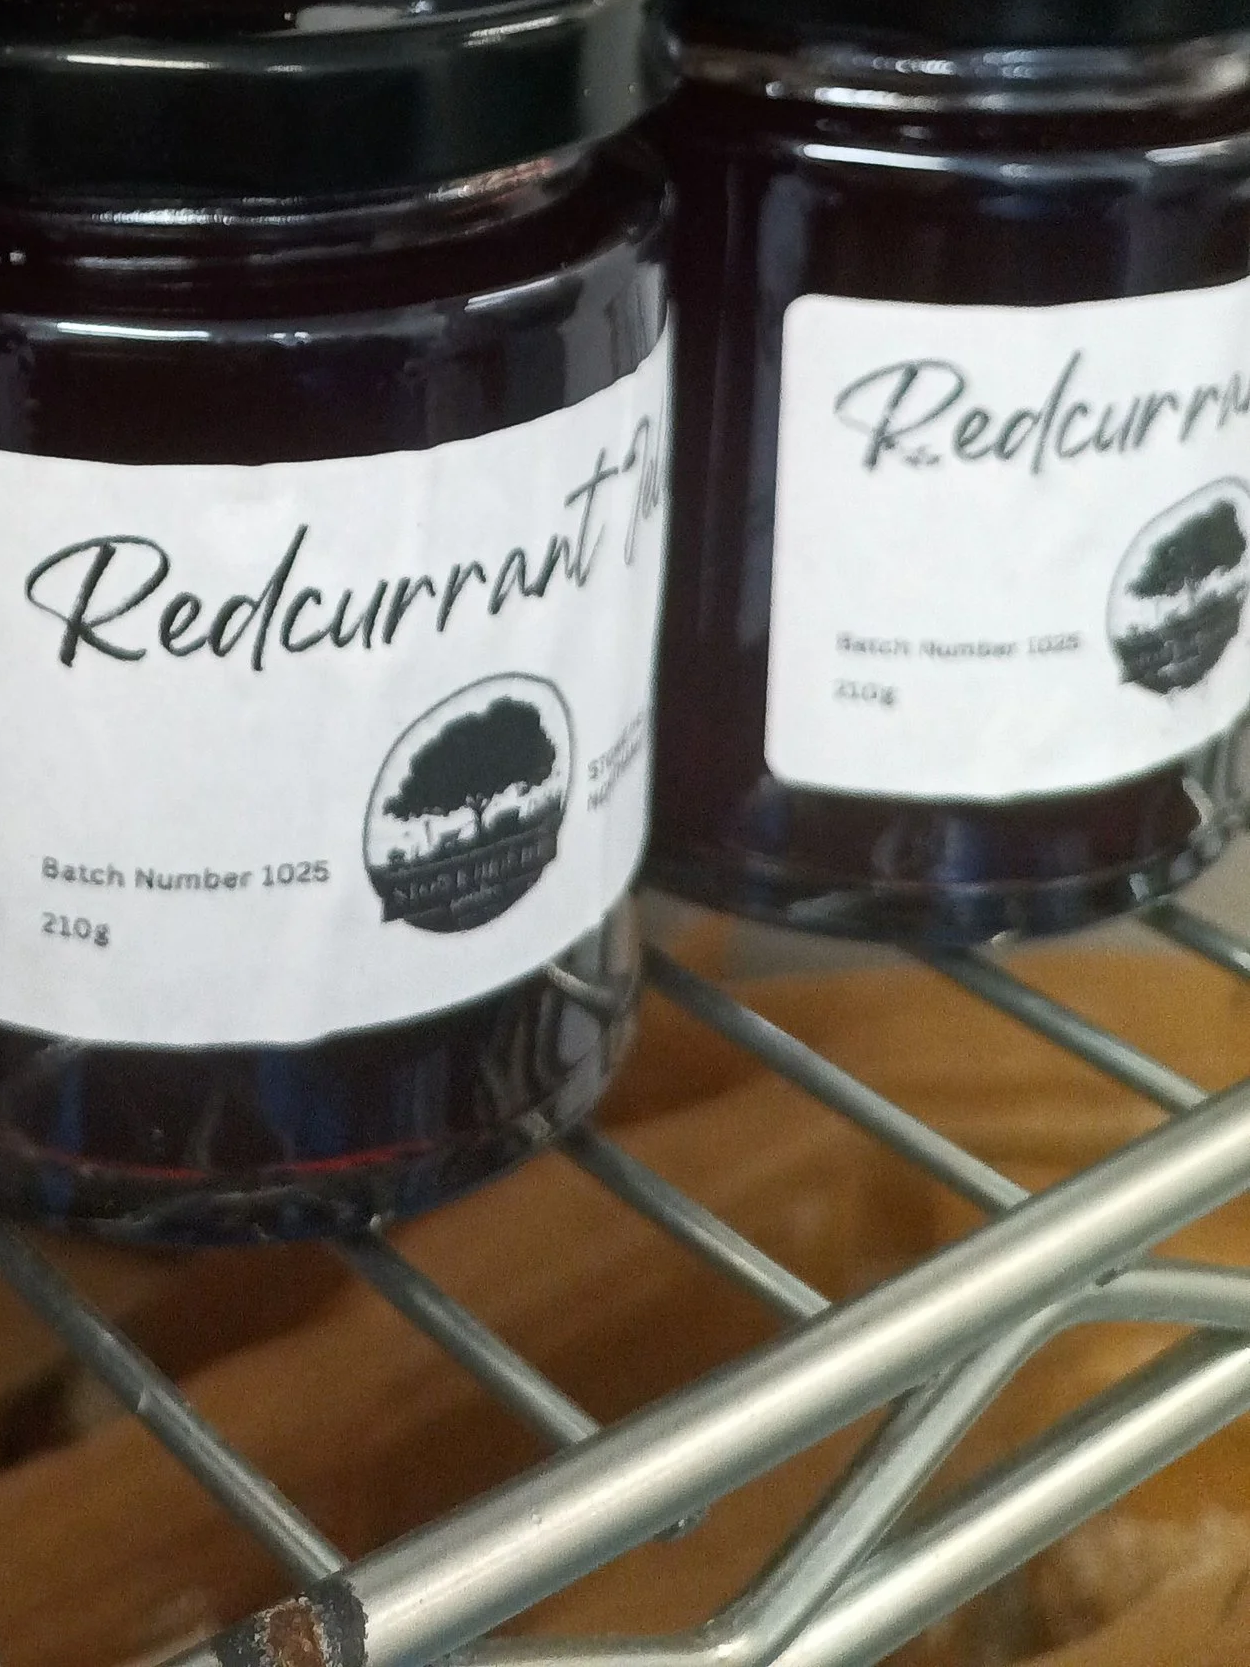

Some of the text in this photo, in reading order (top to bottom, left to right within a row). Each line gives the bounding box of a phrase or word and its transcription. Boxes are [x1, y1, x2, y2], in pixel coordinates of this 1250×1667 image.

[25, 447, 619, 672] Redcurrant
[41, 855, 331, 893] Batch Number 1025
[40, 911, 111, 950] 210g
